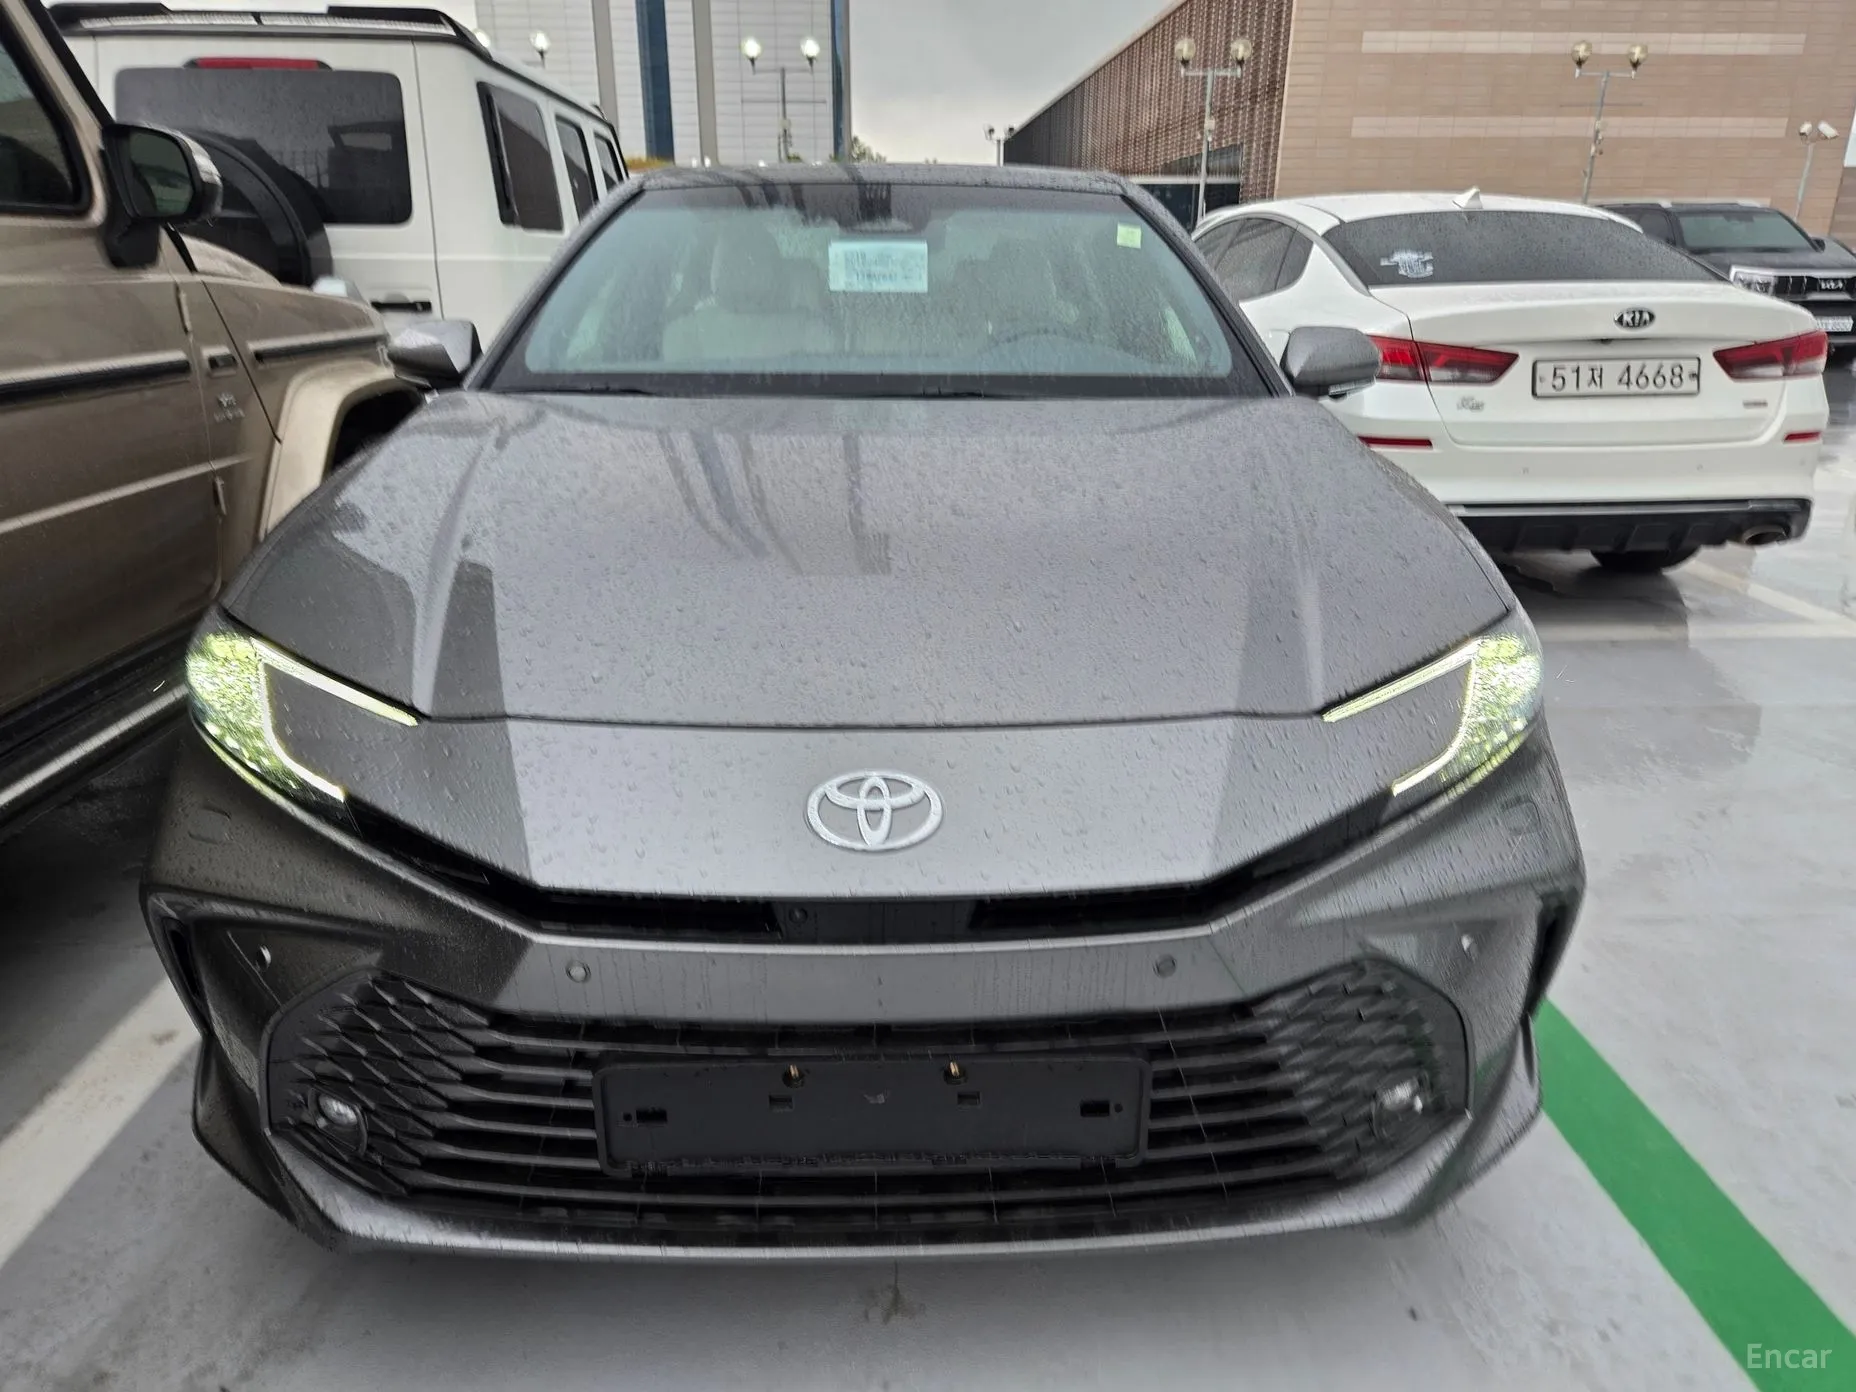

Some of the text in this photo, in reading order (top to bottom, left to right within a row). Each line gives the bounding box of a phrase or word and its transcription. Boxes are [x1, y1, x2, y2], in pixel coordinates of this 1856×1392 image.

[1620, 309, 1651, 328] KIA
[1551, 363, 1684, 392] 51저 4668
